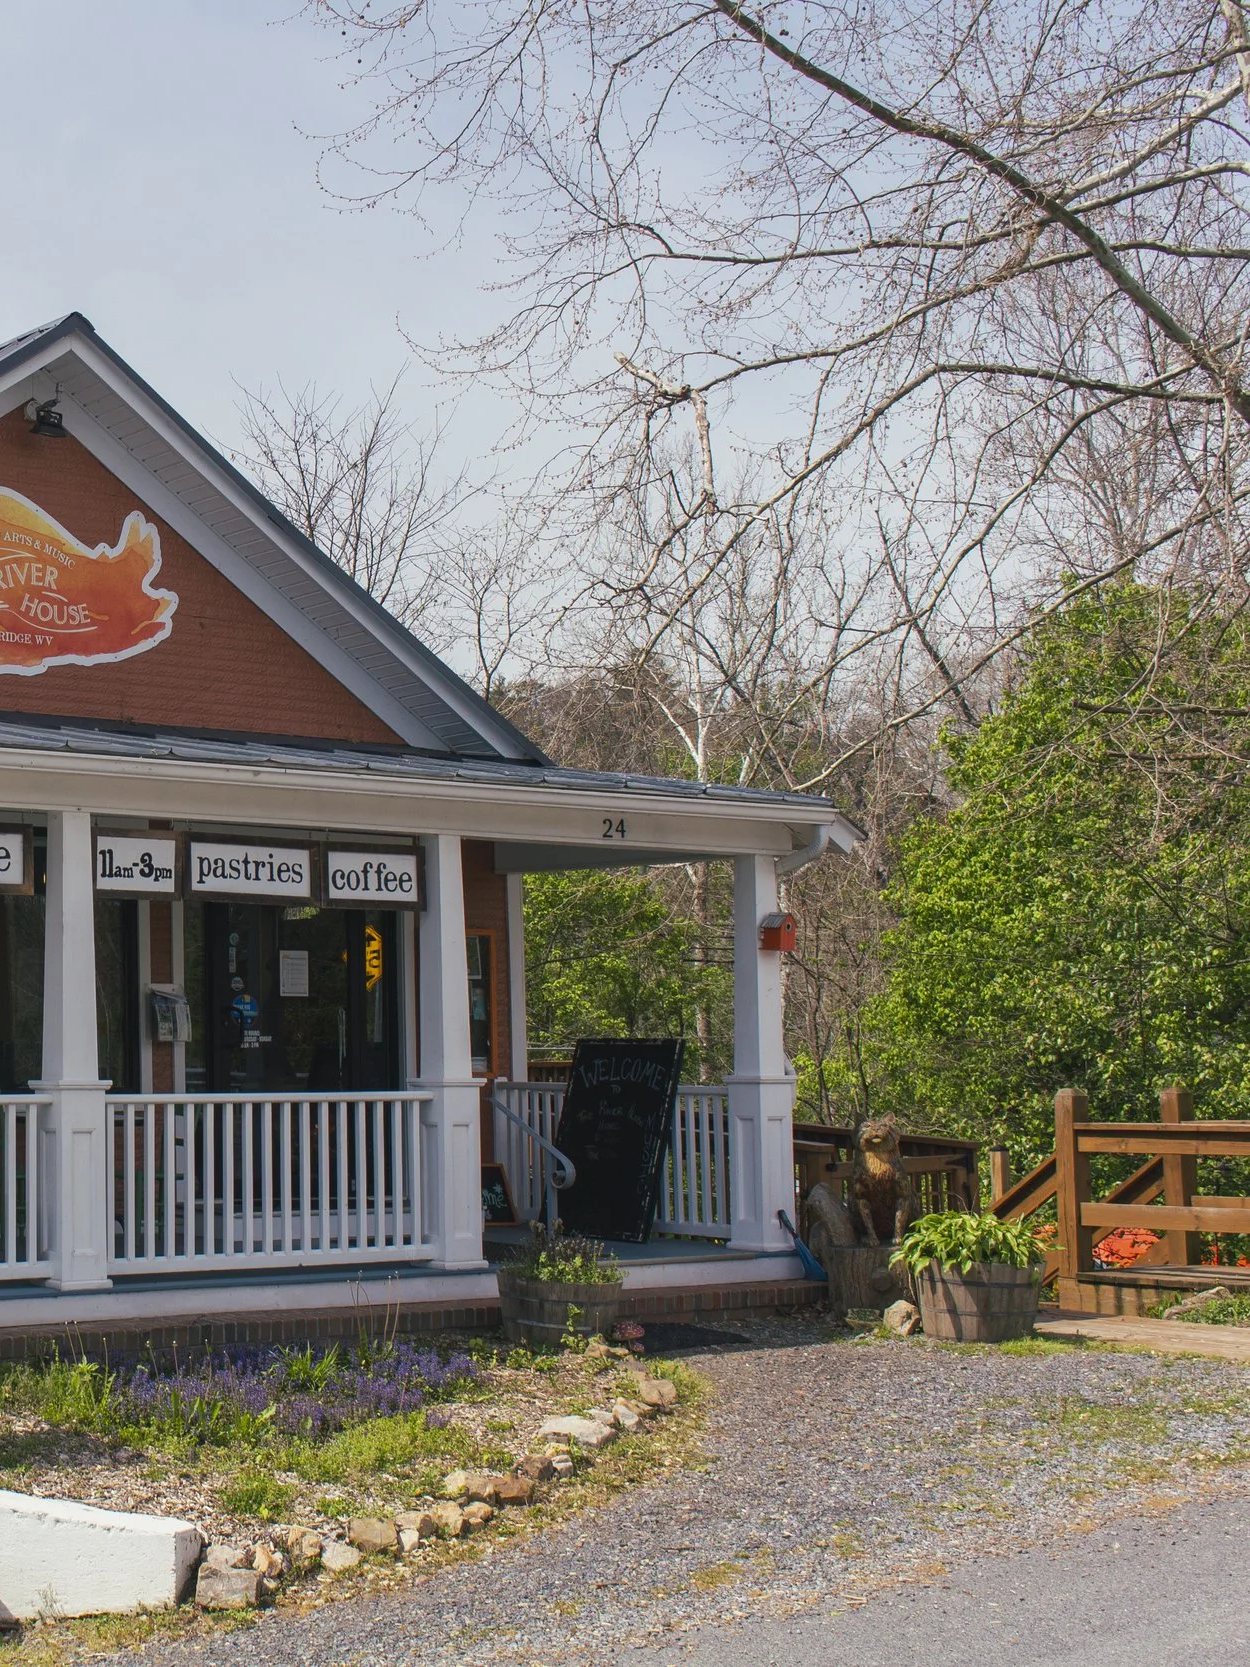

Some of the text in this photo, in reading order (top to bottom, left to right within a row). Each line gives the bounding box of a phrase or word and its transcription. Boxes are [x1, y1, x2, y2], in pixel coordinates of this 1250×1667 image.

[3, 531, 33, 547] ARTS
[33, 539, 42, 550] &
[43, 542, 76, 570] MUSIC
[19, 592, 91, 625] HOUSE
[34, 634, 54, 646] WV
[602, 818, 627, 838] 24
[196, 852, 304, 885] pastries
[330, 861, 414, 893] coffee
[578, 1055, 667, 1091] WELCOME
